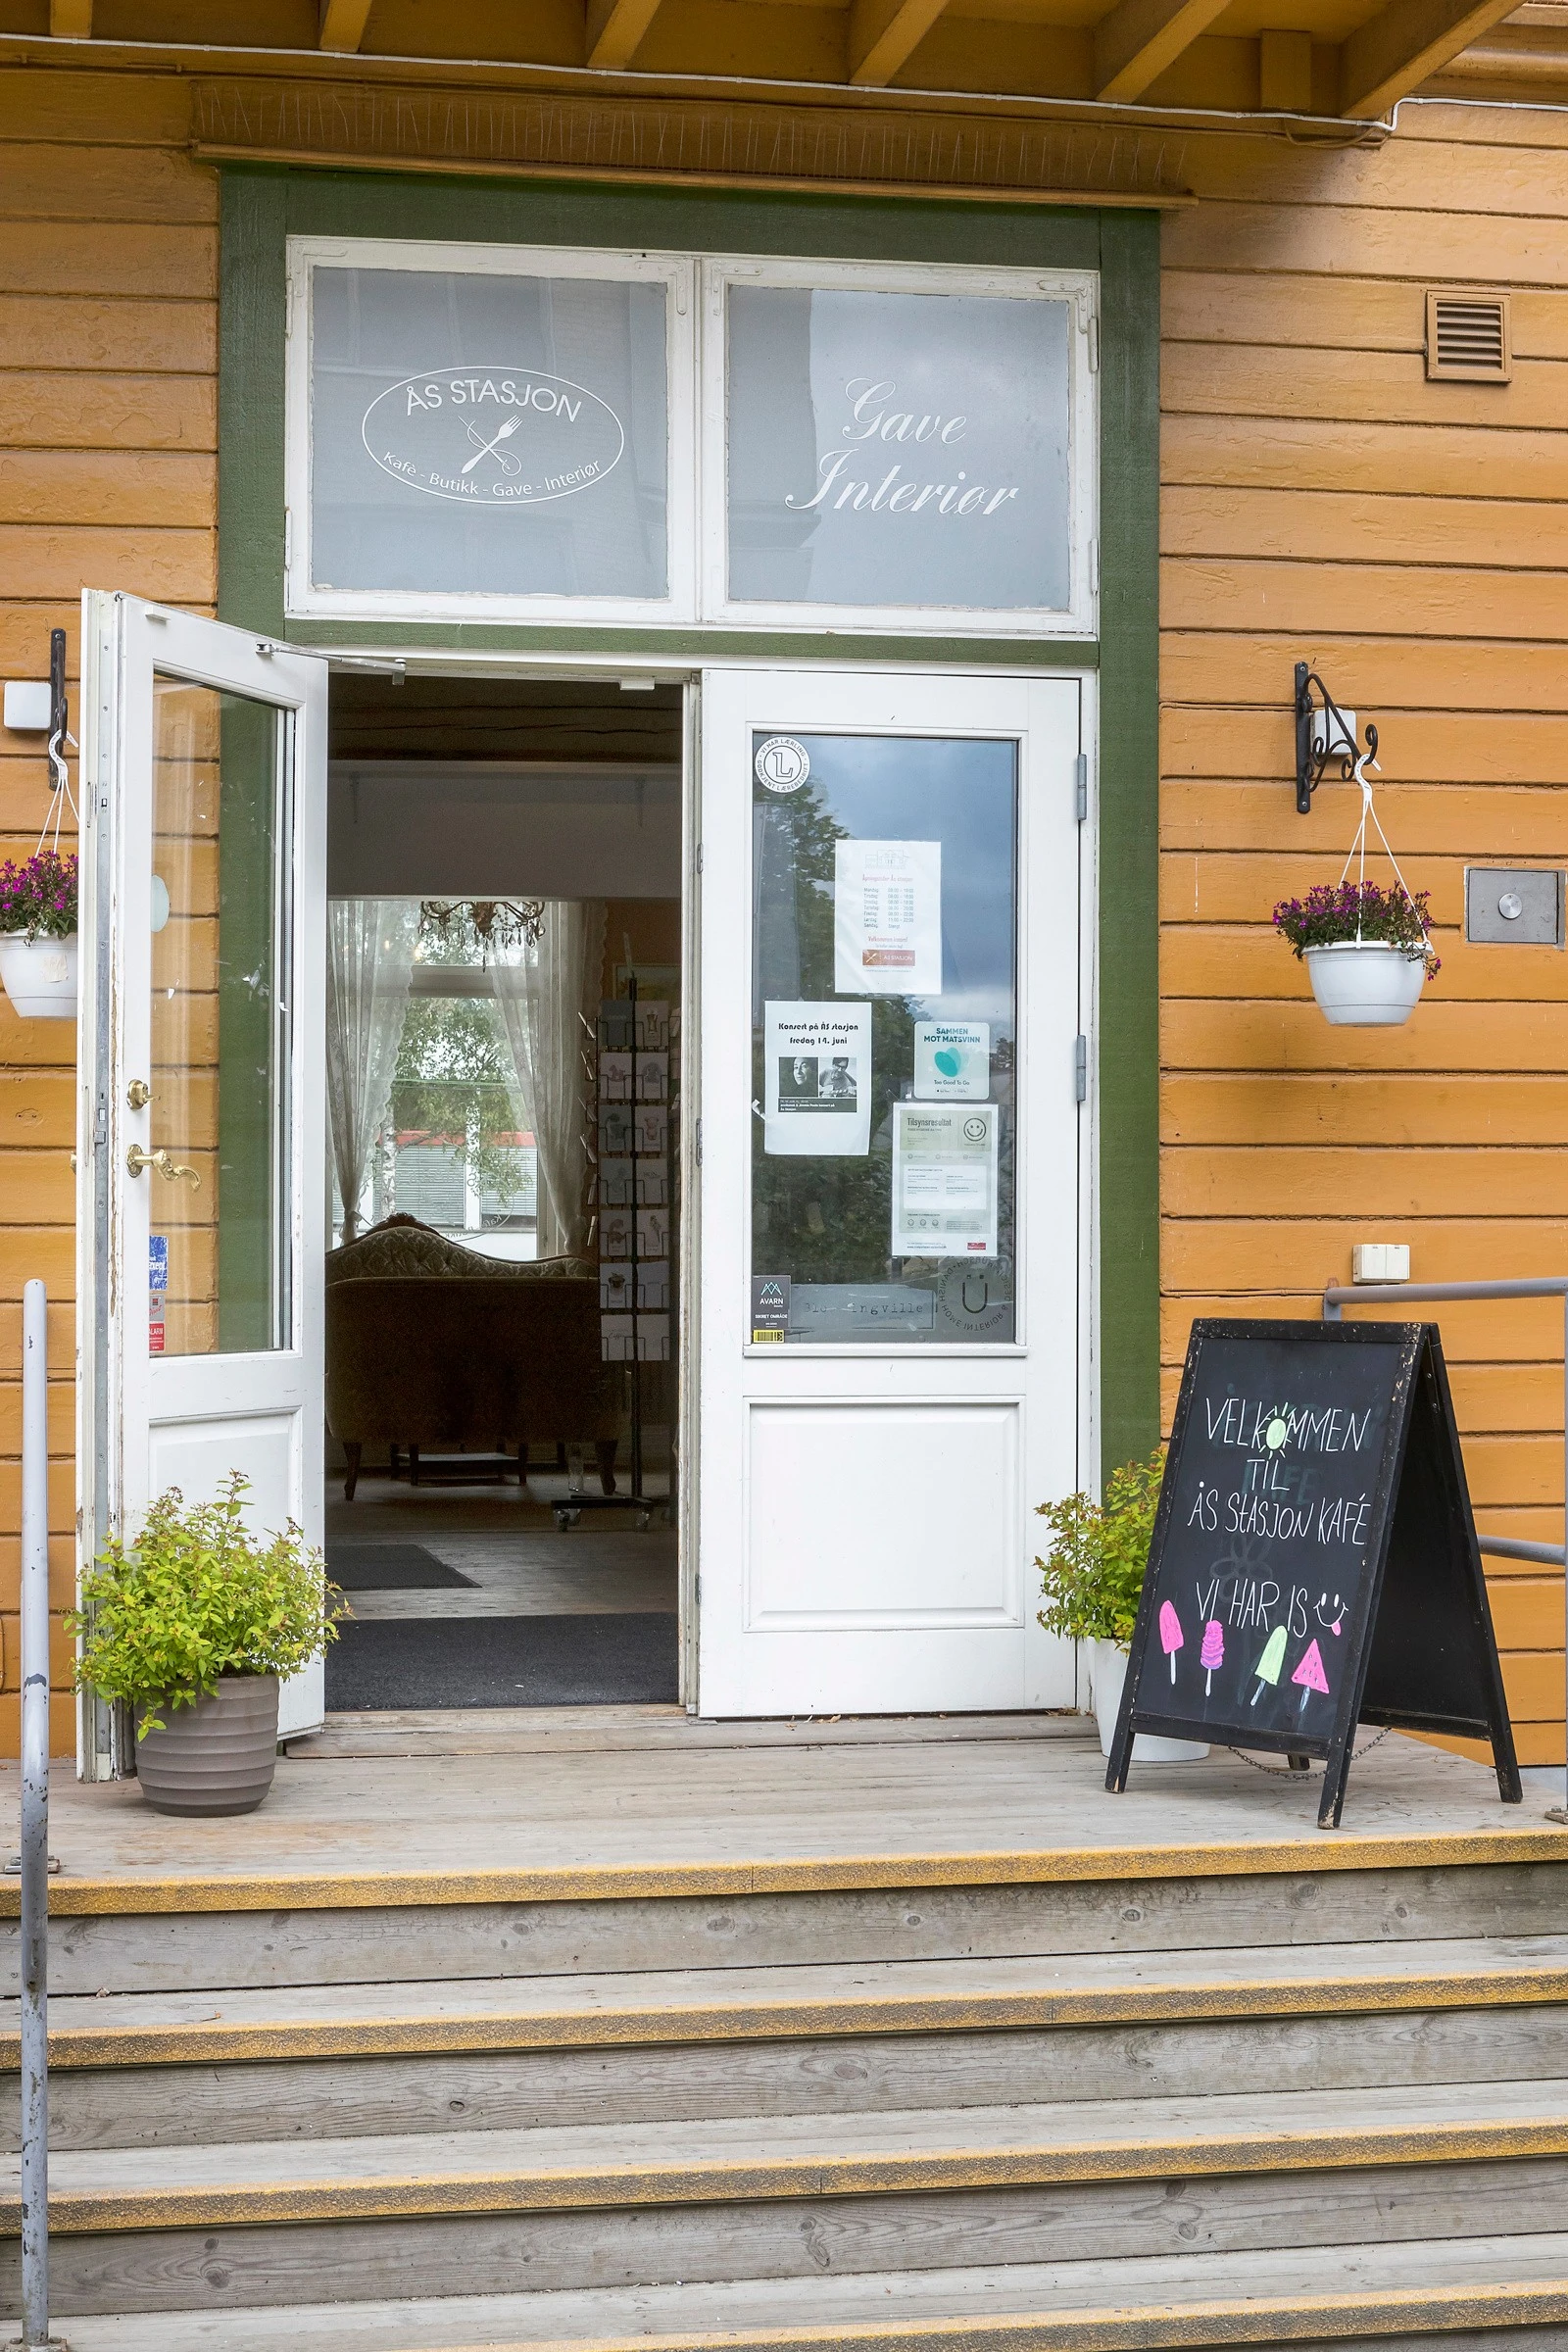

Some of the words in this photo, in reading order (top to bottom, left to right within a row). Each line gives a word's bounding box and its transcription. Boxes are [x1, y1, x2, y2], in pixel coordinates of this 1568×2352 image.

[407, 385, 442, 416] ÅS
[450, 379, 582, 422] STASJON
[842, 377, 967, 444] Gave
[429, 472, 479, 495] Butikk
[492, 482, 532, 498] Gave
[544, 460, 601, 491] Interiør
[766, 739, 779, 748] HAR
[780, 739, 806, 757] LÆRLING
[758, 760, 776, 789] GODKJENT
[776, 762, 808, 791] LÆREBEDRIFT
[789, 1037, 815, 1046] fredag
[831, 1036, 848, 1046] juni
[831, 1022, 858, 1032] stasjon
[907, 1117, 952, 1128] Tilsynsresultat
[1206, 1397, 1372, 1454] VELKOMMEN
[1247, 1459, 1290, 1491] TIL
[1187, 1481, 1219, 1532] ÅS
[1317, 1493, 1371, 1545] KAFÉ
[1196, 1579, 1220, 1622] VI
[1228, 1578, 1280, 1633] HAR
[1288, 1585, 1308, 1639] IS
